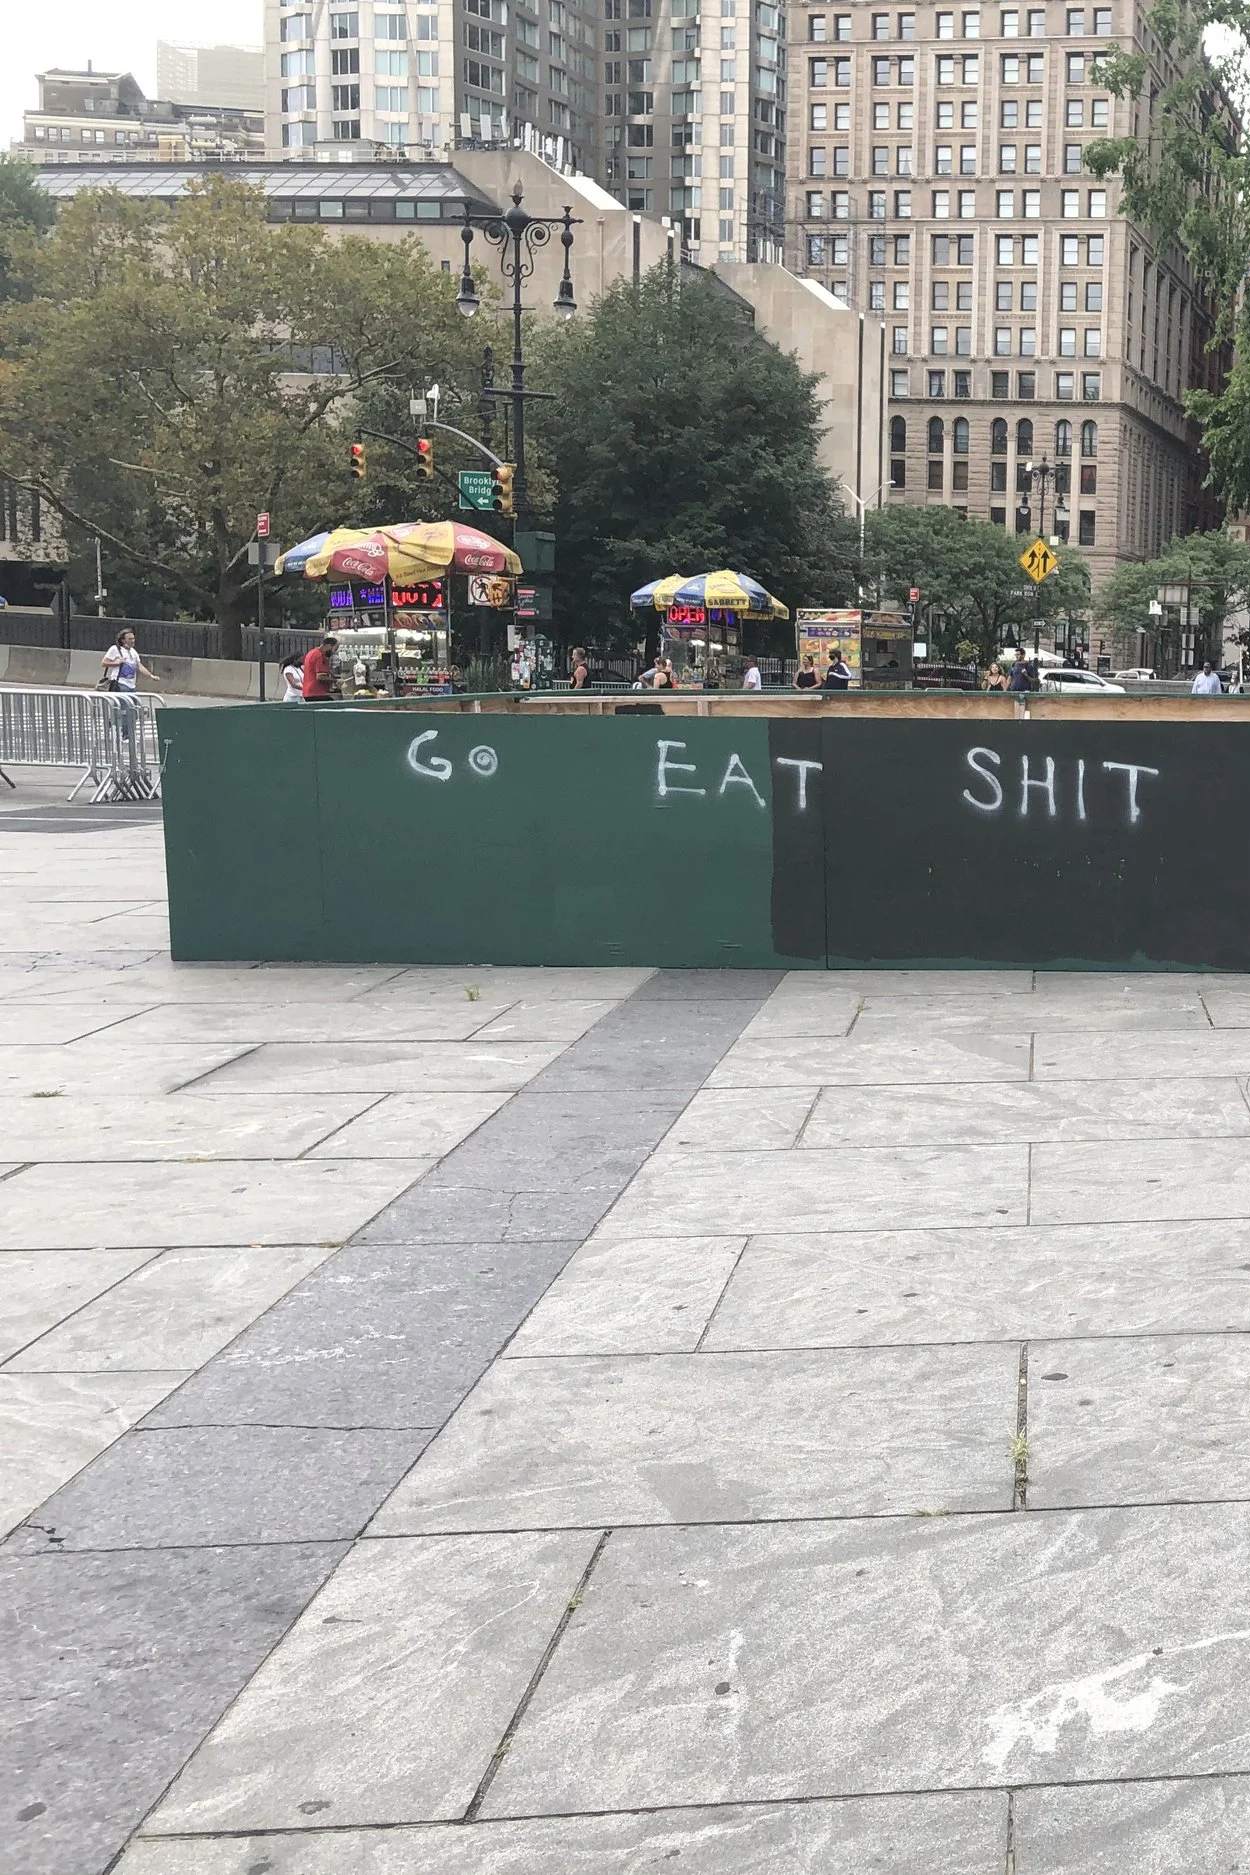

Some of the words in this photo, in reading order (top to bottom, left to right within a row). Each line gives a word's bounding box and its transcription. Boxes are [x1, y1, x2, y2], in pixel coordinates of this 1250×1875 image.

[469, 486, 492, 496] Bridg
[708, 598, 746, 606] SABRETT
[669, 605, 705, 623] OPEN
[655, 739, 824, 809] EAT
[962, 746, 1159, 823] SHIT
